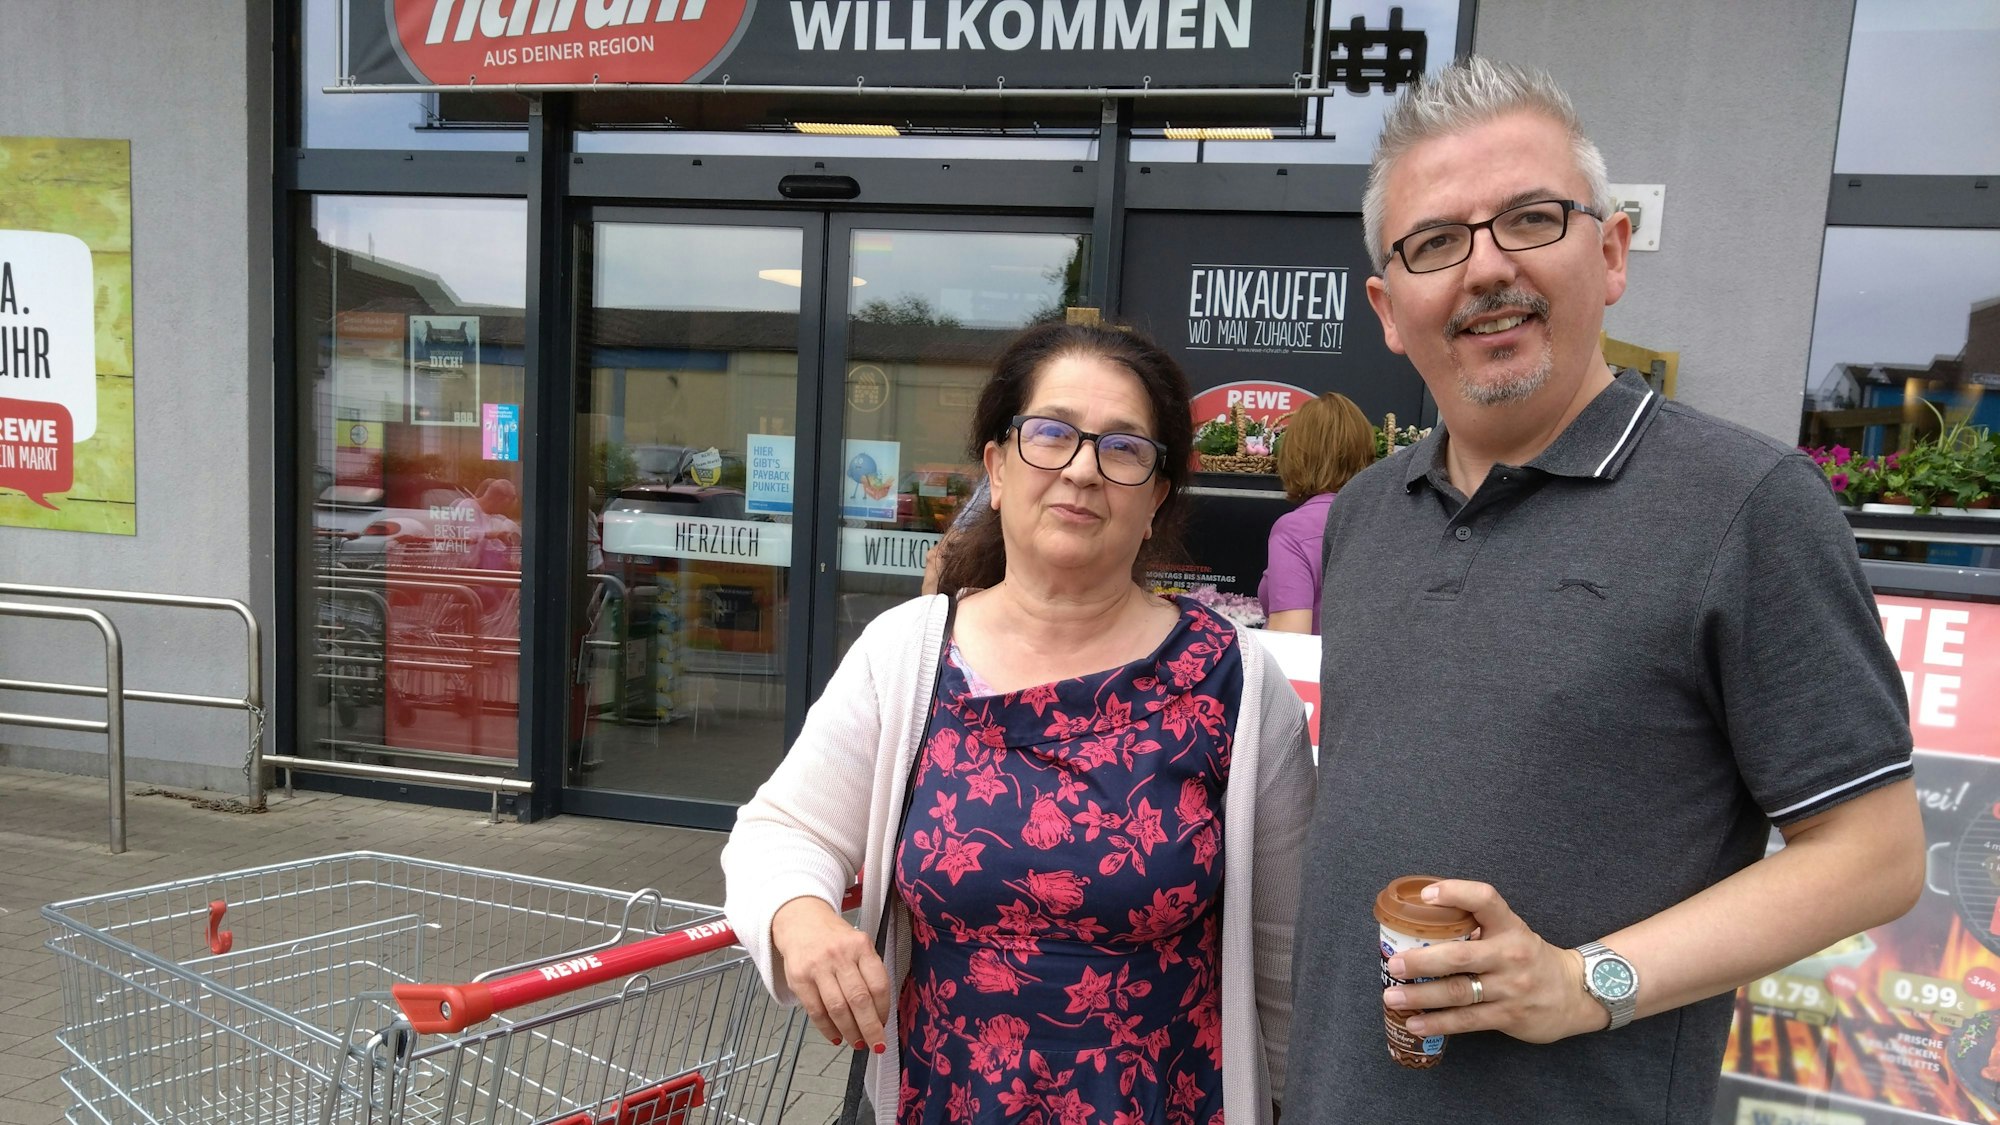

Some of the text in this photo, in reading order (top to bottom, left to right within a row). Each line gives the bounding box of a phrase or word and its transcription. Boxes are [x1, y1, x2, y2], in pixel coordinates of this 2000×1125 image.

[790, 0, 1252, 51] WILLKOMMEN
[483, 35, 655, 67] AUS DEINER REGION
[1189, 269, 1348, 321] EINKAUFEN
[1188, 319, 1344, 349] WO MAN ZUHAUSE IST!
[429, 355, 464, 369] DICH!
[1226, 389, 1292, 411] REWE
[19, 446, 58, 472] MARKT
[753, 446, 774, 456] HIER
[753, 458, 781, 468] GIBT'S
[752, 470, 790, 481] PAYBACK
[752, 481, 790, 493] PUNKTE!
[429, 505, 475, 521] REWE
[434, 524, 471, 539] BESTE
[433, 539, 471, 553] WAHL
[675, 522, 938, 569] HERZLICH WILLKO
[1146, 571, 1182, 580] MONTAGS
[1196, 573, 1237, 583] SAMSTAGS
[538, 954, 603, 981] REWE
[1967, 975, 1997, 993] -34%
[1897, 1032, 1944, 1050] FRISCHE
